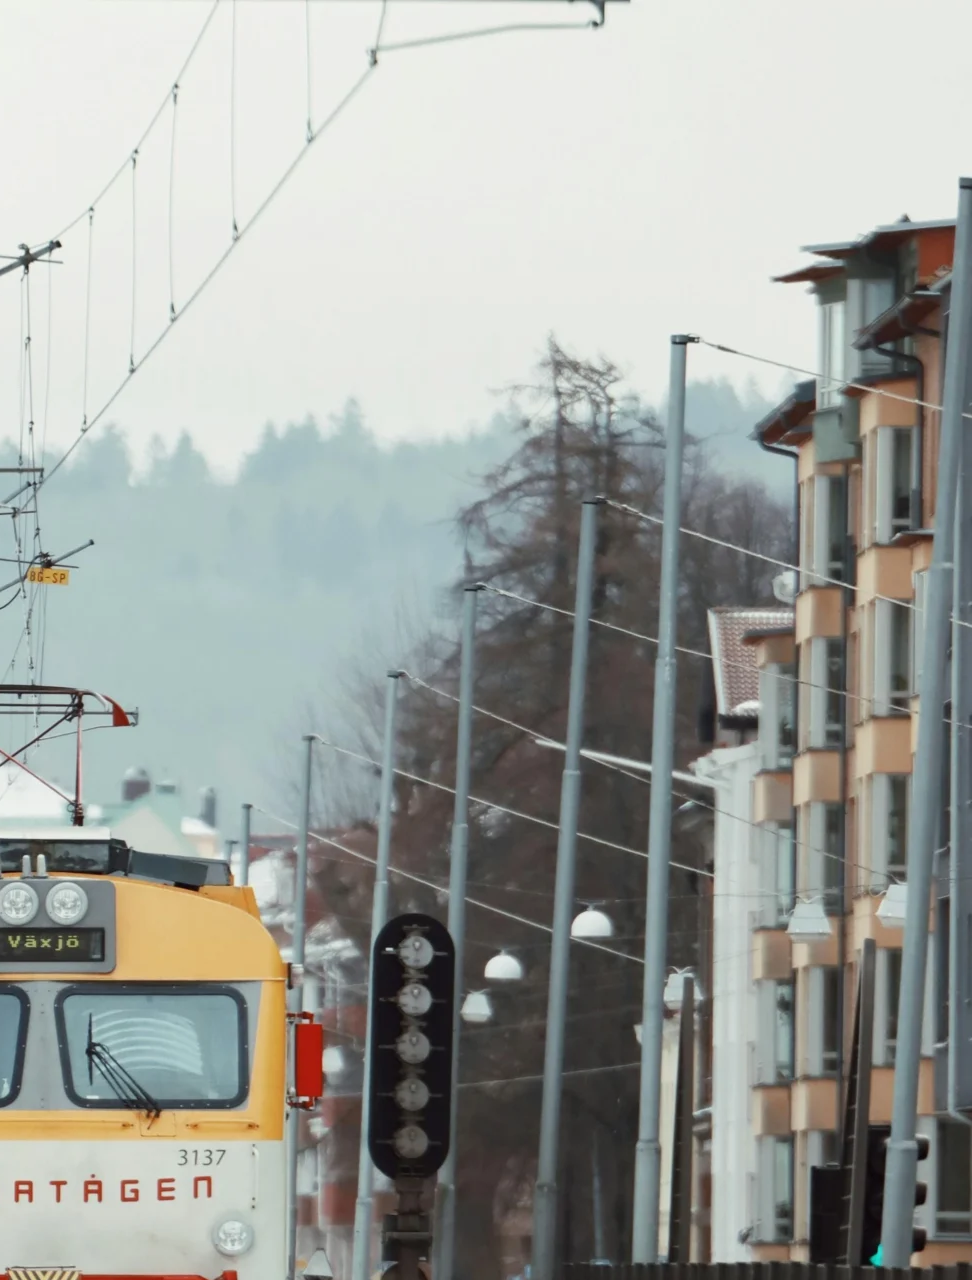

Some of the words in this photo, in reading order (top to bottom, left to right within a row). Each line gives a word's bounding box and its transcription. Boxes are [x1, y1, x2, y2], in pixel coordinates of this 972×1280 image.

[29, 570, 66, 584] BG-SP
[8, 935, 79, 951] Växjö
[177, 1148, 227, 1167] 3137
